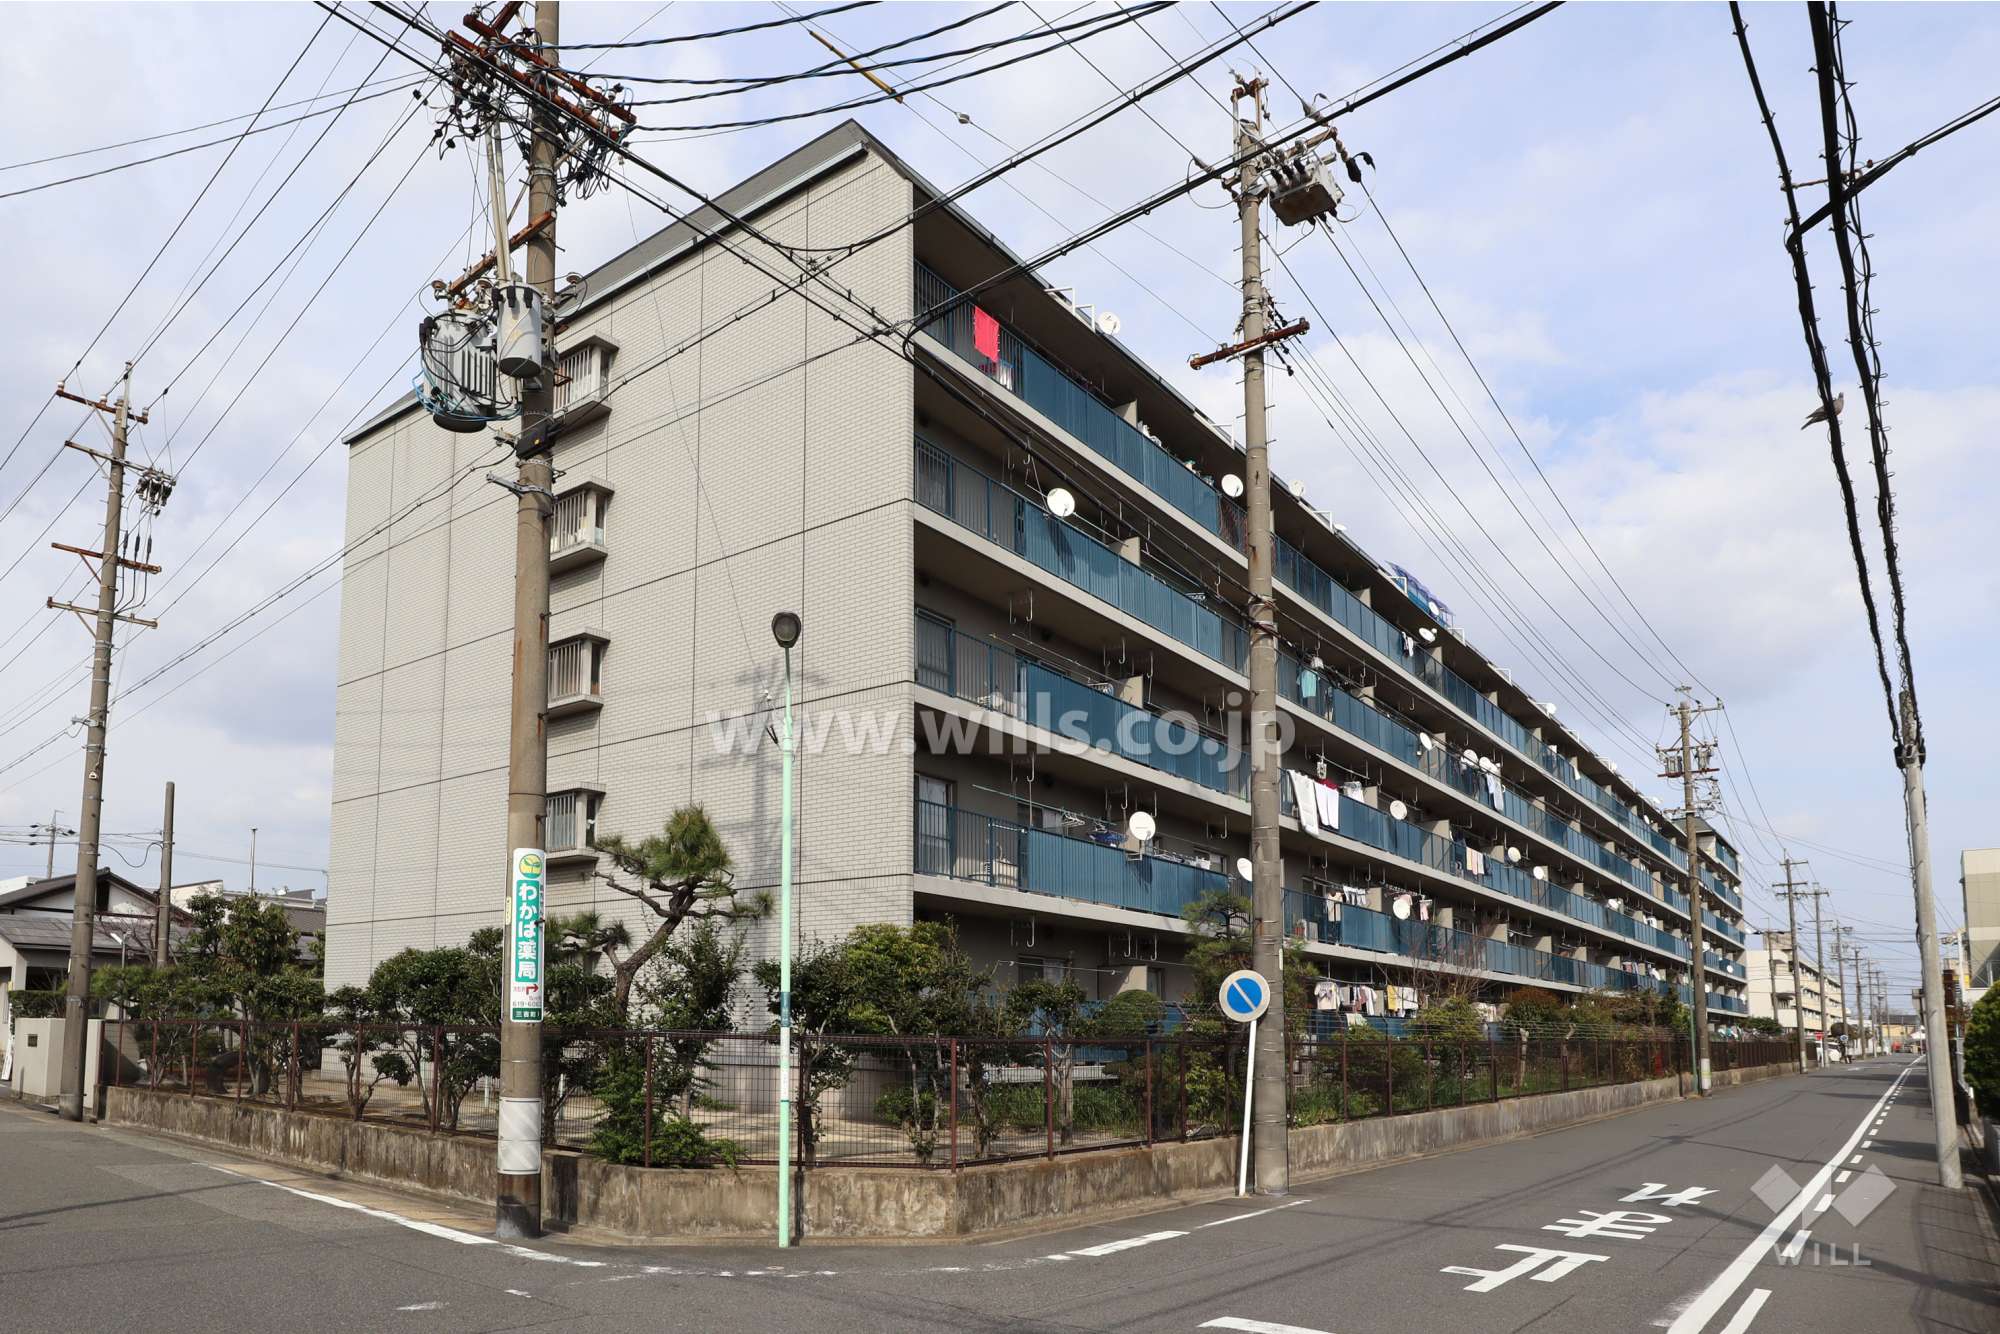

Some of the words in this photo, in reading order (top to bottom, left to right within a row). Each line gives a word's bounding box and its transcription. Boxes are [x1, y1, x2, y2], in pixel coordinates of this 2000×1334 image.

[517, 882, 538, 979] わかば薬局
